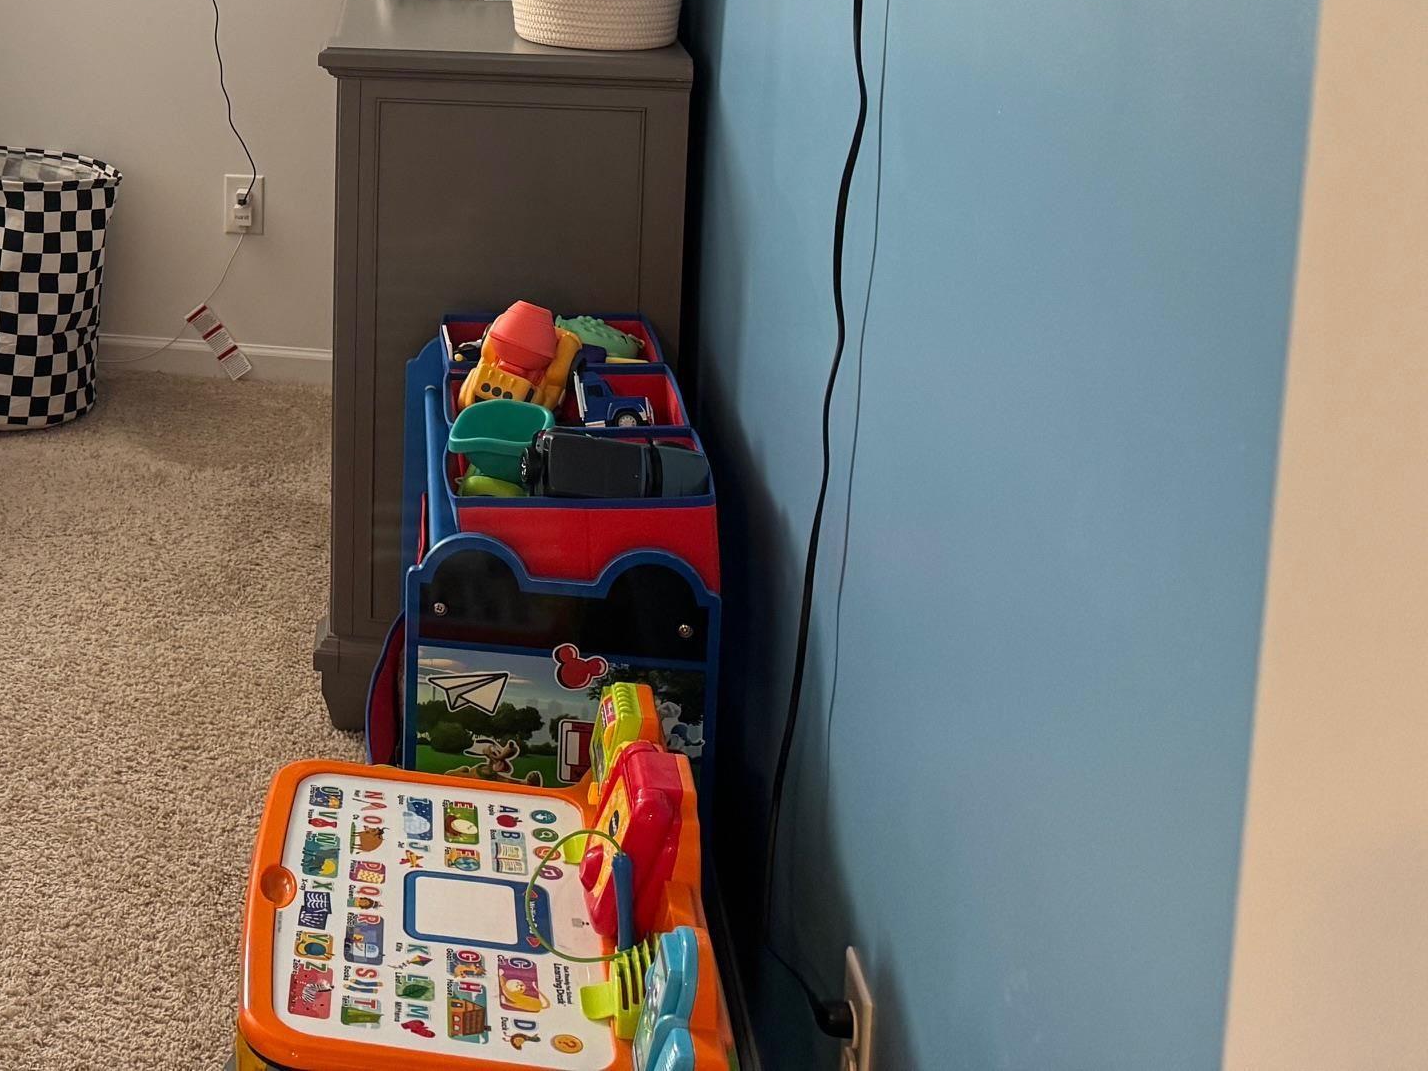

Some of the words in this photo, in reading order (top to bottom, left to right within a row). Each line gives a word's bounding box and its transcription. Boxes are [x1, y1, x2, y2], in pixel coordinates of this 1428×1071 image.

[500, 805, 519, 813] A
[501, 831, 521, 839] B
[407, 944, 429, 955] K
[553, 963, 563, 989] Learning
[446, 978, 454, 997] House
